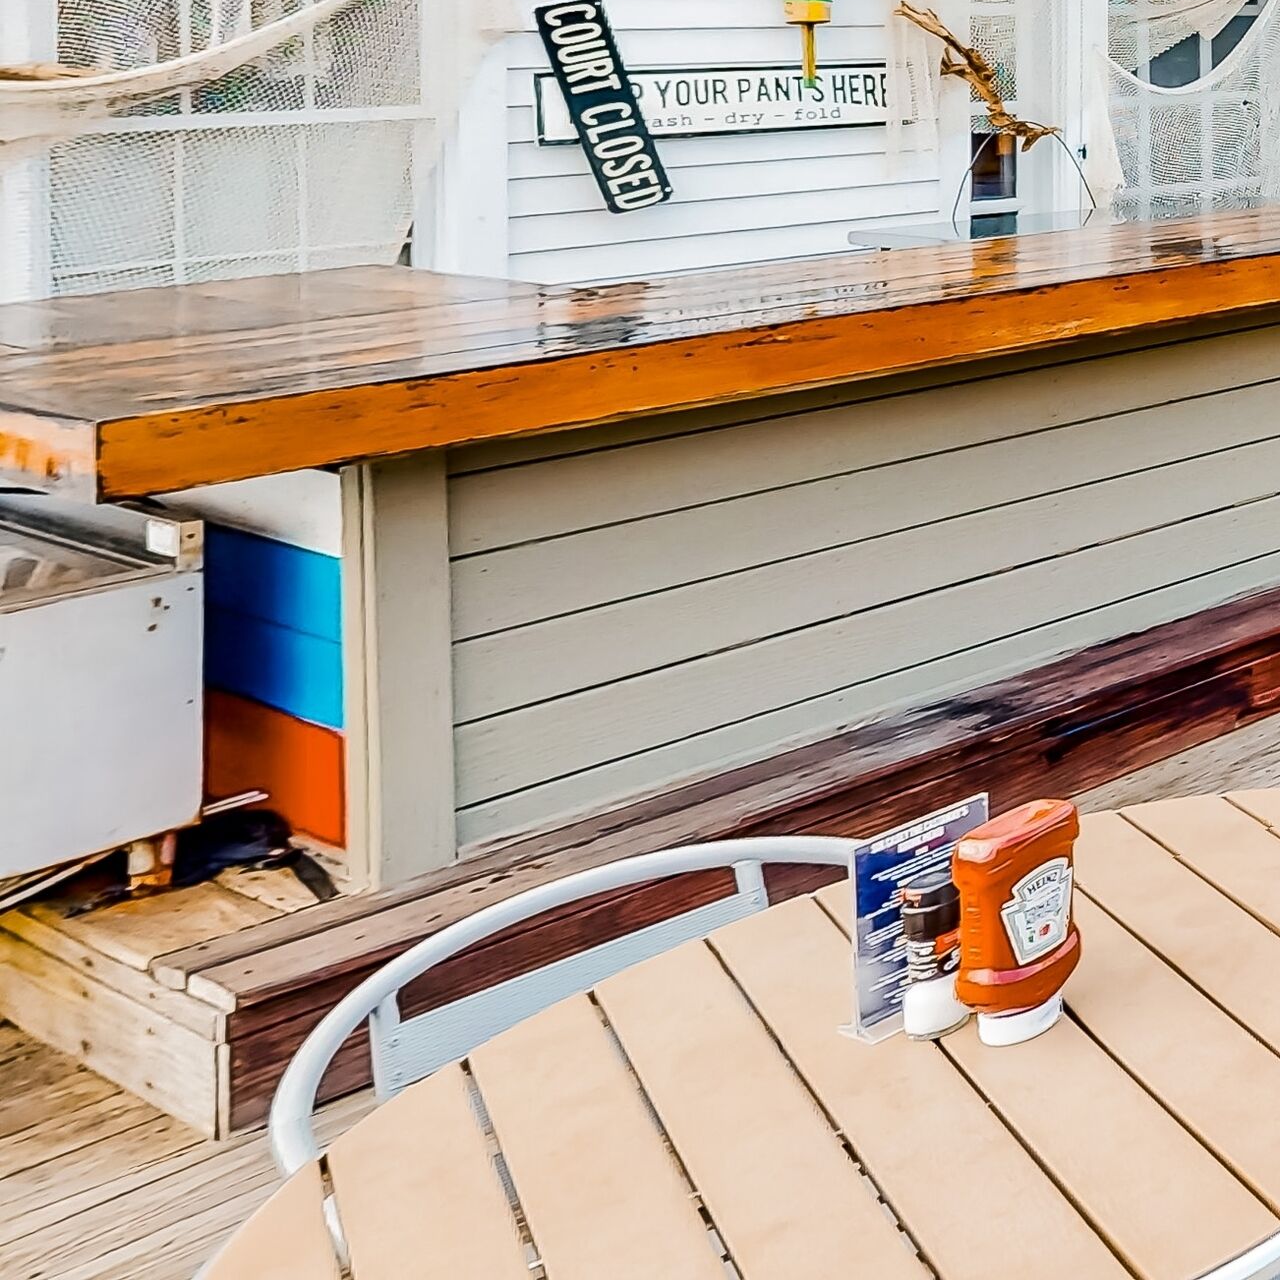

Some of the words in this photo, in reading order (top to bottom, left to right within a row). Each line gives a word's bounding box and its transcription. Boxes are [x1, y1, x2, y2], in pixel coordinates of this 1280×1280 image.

[544, 2, 622, 95] COURT
[654, 78, 729, 108] YOUR
[738, 74, 825, 104] PANTS
[652, 114, 693, 129] ash
[725, 109, 766, 127] dry
[794, 106, 842, 121] fold
[580, 101, 666, 212] CLOSED
[1026, 871, 1059, 896] HEINZ
